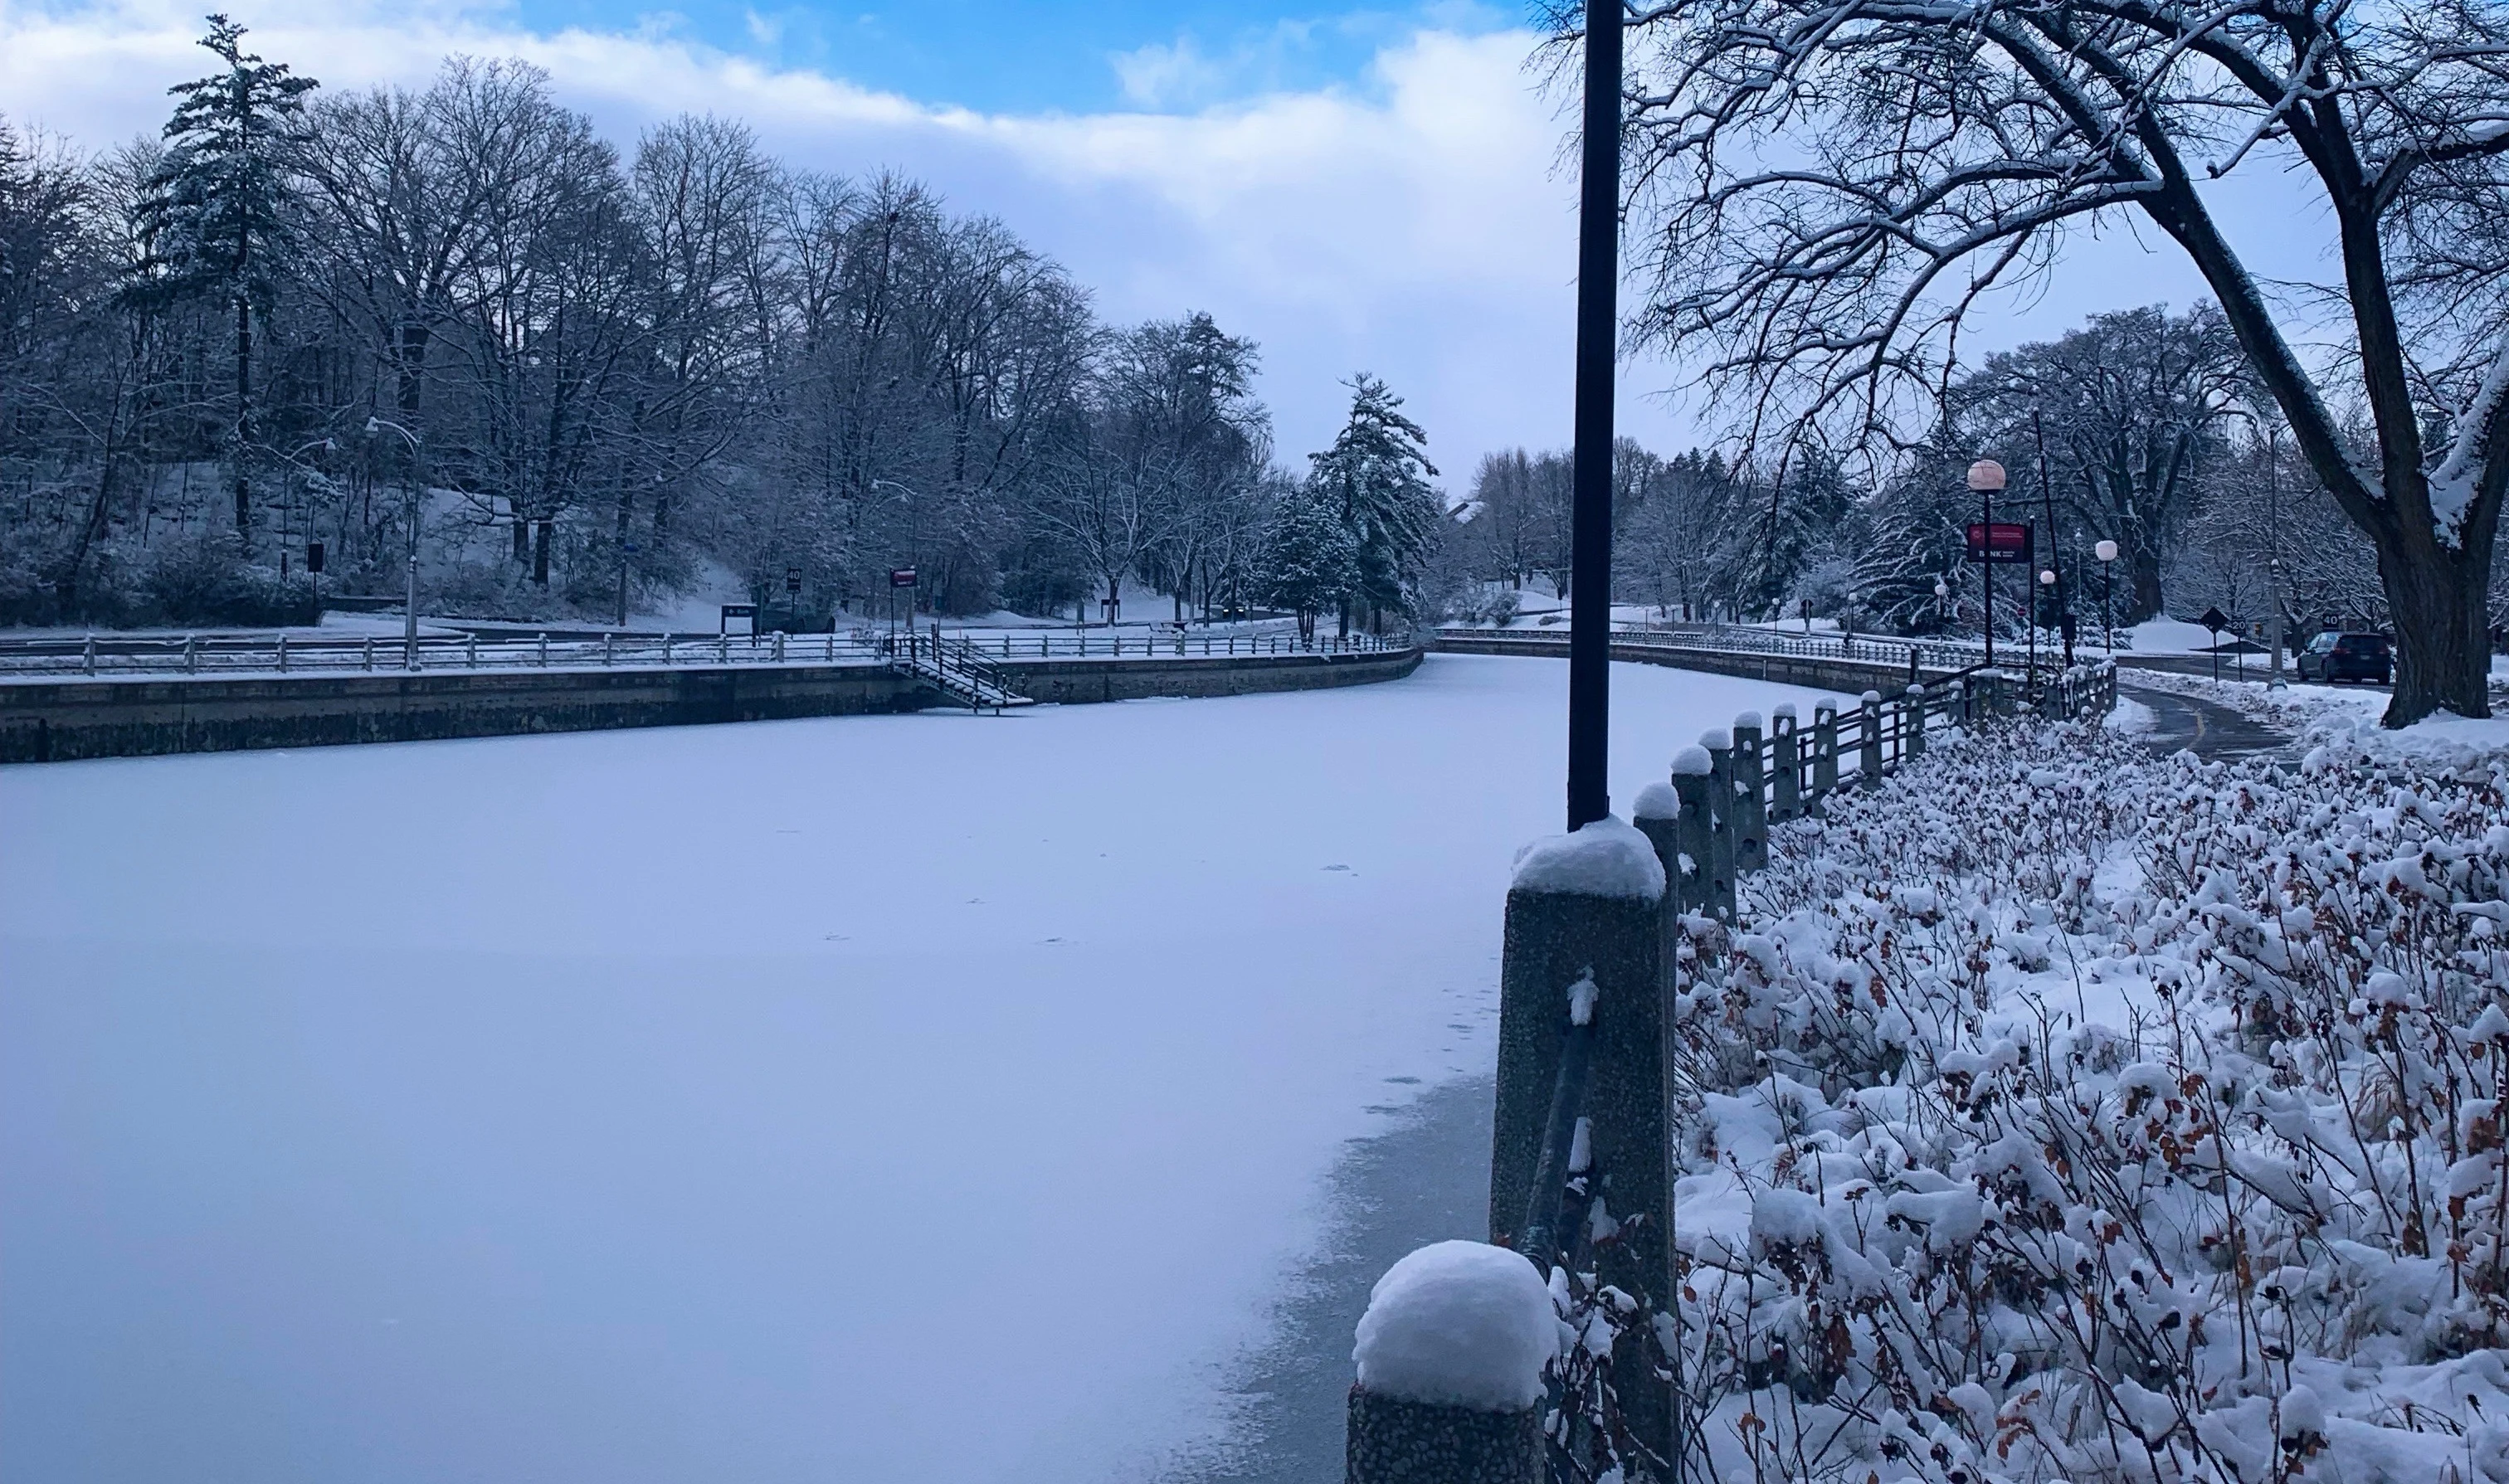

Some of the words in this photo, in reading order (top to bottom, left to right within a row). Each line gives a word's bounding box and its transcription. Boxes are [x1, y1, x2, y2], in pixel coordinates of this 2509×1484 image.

[787, 571, 800, 580] 40
[2324, 615, 2338, 625] 40
[2232, 621, 2245, 630] 20
